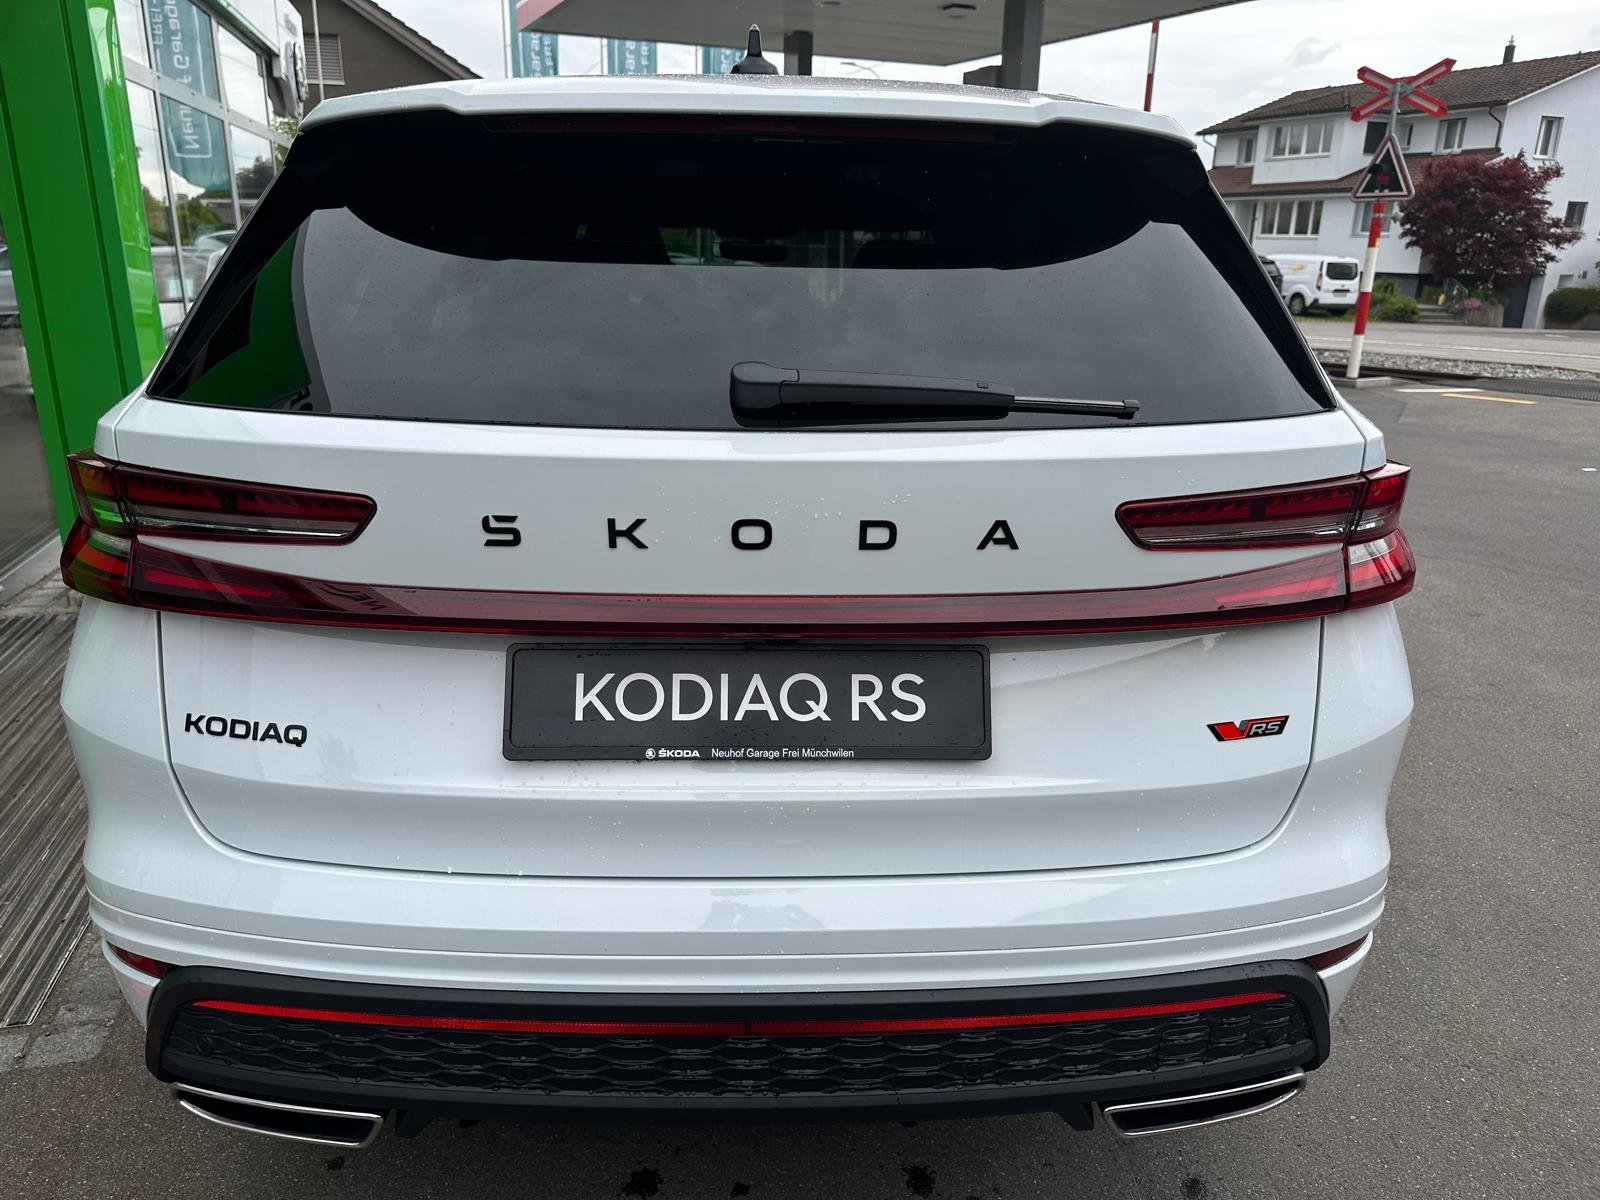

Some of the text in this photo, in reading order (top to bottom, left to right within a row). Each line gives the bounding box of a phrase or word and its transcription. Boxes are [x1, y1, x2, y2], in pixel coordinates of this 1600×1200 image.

[574, 672, 926, 722] KODIAQ RS
[184, 712, 308, 747] KODIAQ
[711, 748, 744, 758] Neuhof
[746, 748, 780, 760] Garage
[782, 748, 800, 758] Frei
[802, 748, 855, 758] Münchwilen
